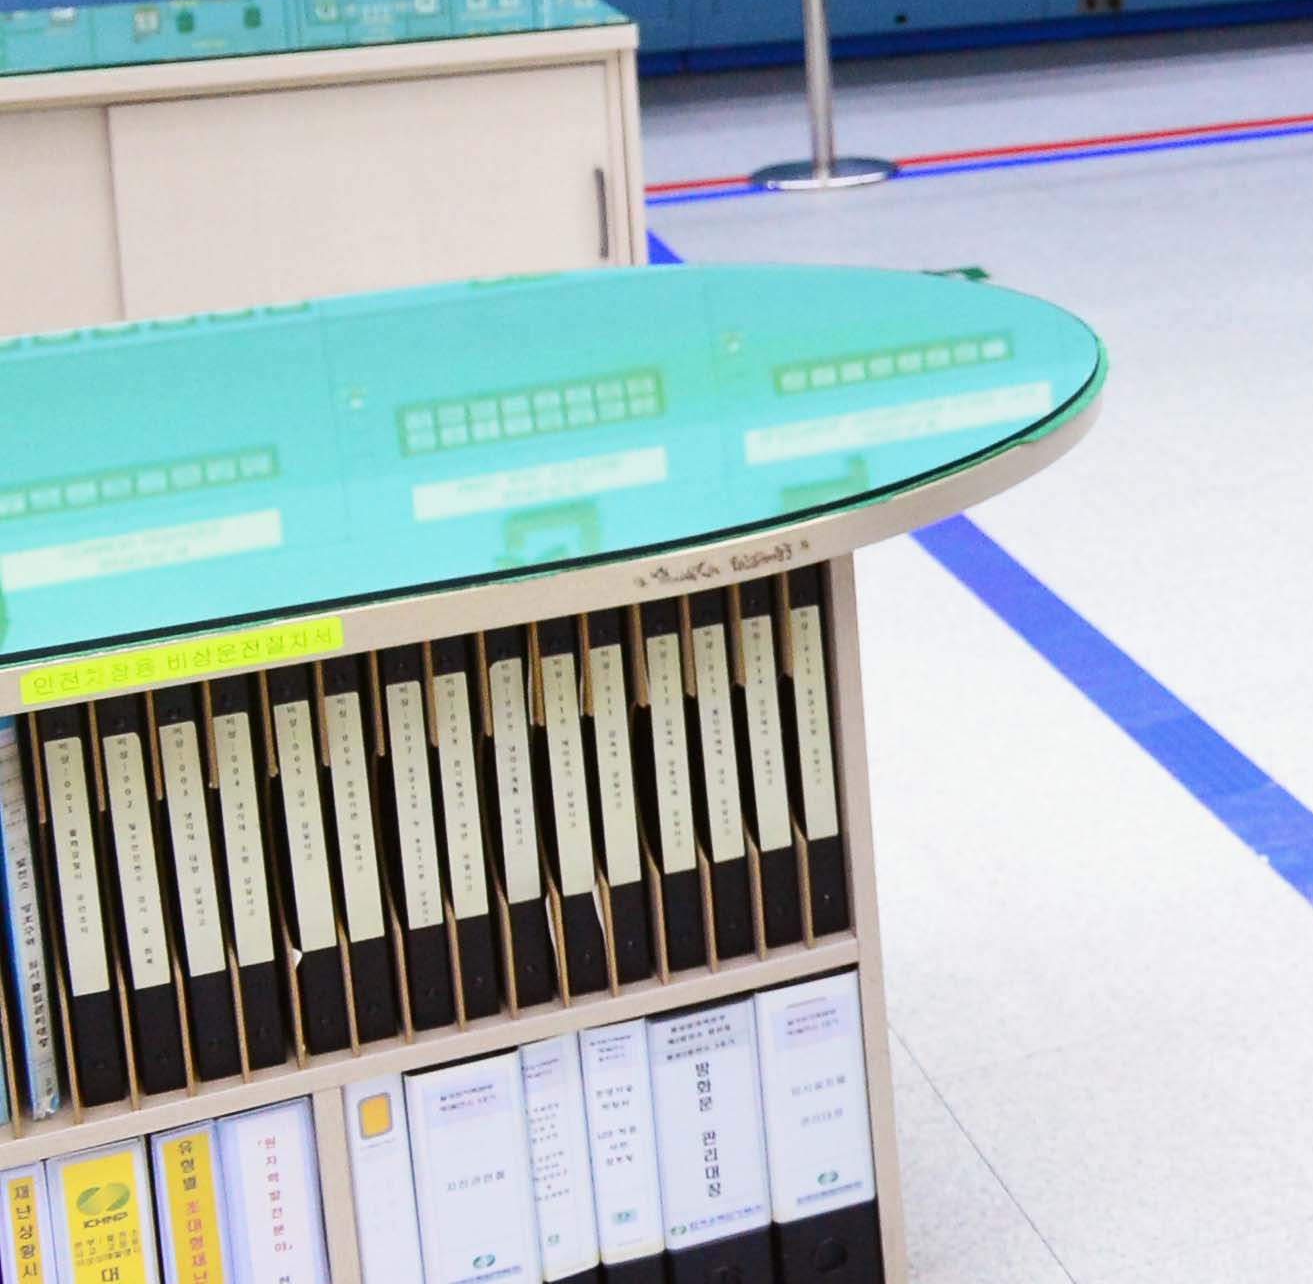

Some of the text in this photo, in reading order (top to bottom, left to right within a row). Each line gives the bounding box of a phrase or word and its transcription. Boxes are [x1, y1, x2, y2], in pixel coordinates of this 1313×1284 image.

[696, 1061, 721, 1198] 방화문 관리대장
[83, 1212, 128, 1228] KHNP
